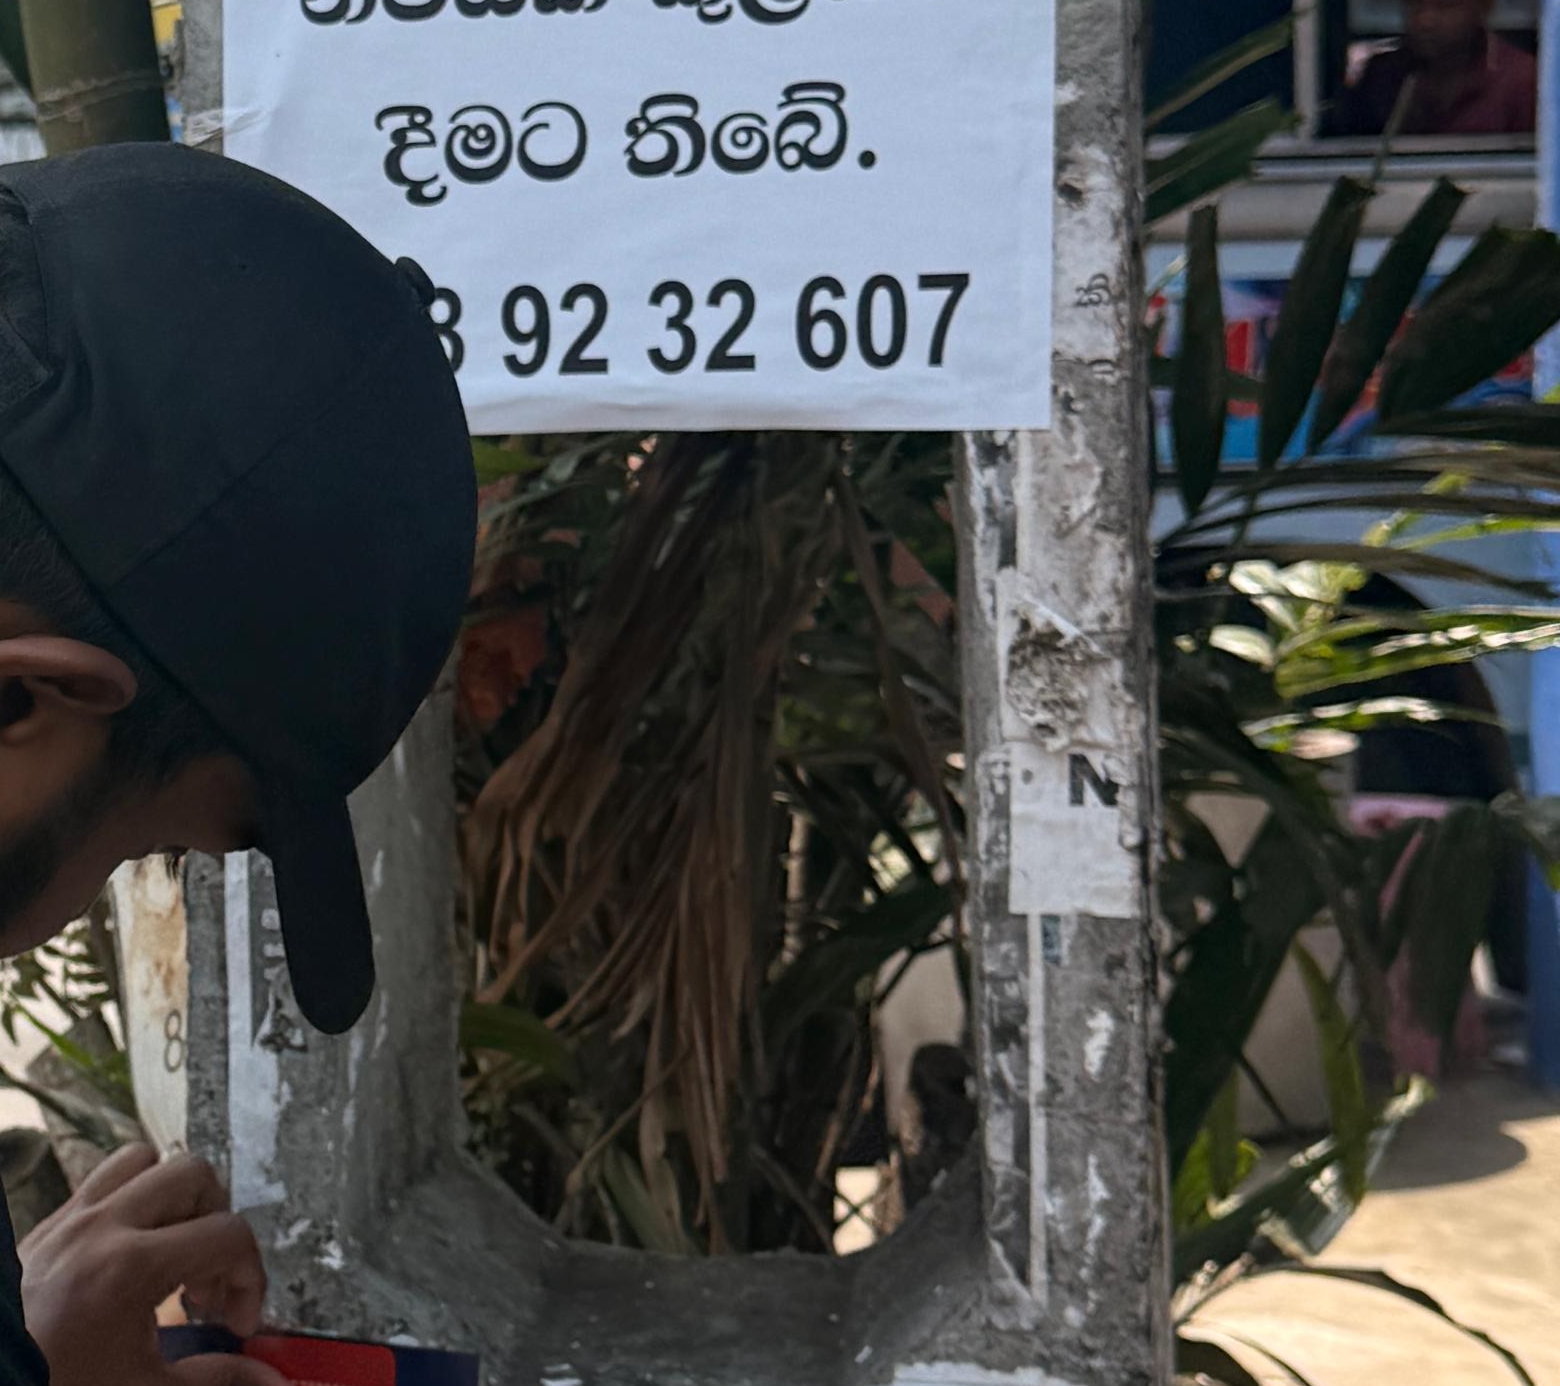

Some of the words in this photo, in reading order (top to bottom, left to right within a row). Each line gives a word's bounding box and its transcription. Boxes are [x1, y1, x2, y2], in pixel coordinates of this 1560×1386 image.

[374, 100, 588, 206] දීමට
[623, 80, 878, 178] තිබේ.
[501, 281, 610, 377] 92
[647, 276, 757, 374] 32
[796, 272, 971, 371] 607
